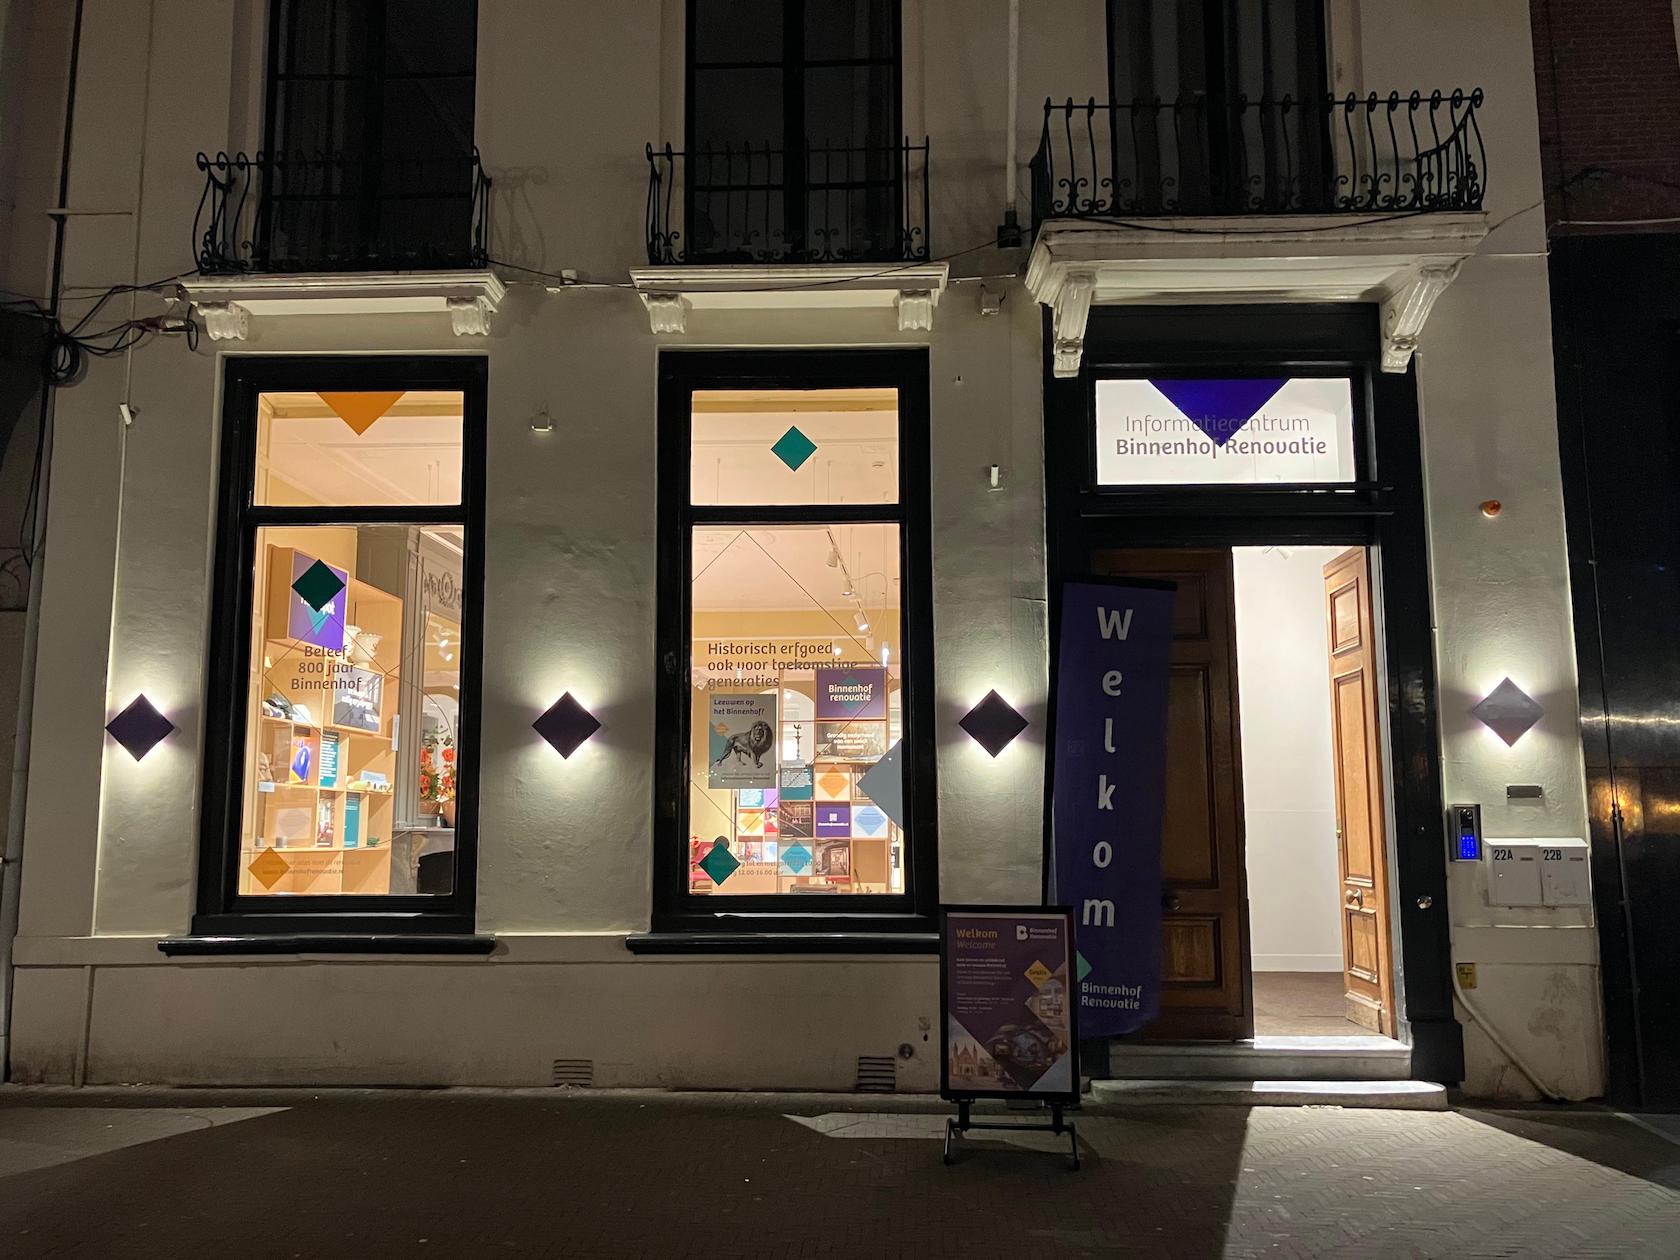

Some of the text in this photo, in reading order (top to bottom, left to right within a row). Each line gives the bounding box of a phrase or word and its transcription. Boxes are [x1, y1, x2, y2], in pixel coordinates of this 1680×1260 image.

[1125, 414, 1310, 436] Informatiecentrum
[1116, 437, 1327, 459] Binnenhof Renovatie
[304, 645, 347, 660] Beleef
[707, 642, 777, 655] Historisch
[298, 662, 355, 677] 800 jaar
[707, 658, 857, 673] ook voor toekomstige
[291, 678, 363, 692] Binnenhof
[707, 674, 779, 691] generaties
[828, 683, 873, 695] Binnenhof
[829, 692, 872, 702] renovatie
[1082, 606, 1136, 928] Welkom
[1494, 849, 1514, 861] 22A
[1543, 849, 1562, 861] 22B
[956, 928, 998, 939] Welkom
[1016, 925, 1029, 940] B
[957, 941, 996, 950] Welcome
[1081, 982, 1143, 999] Binnenhof
[1081, 995, 1140, 1010] Renovatie
